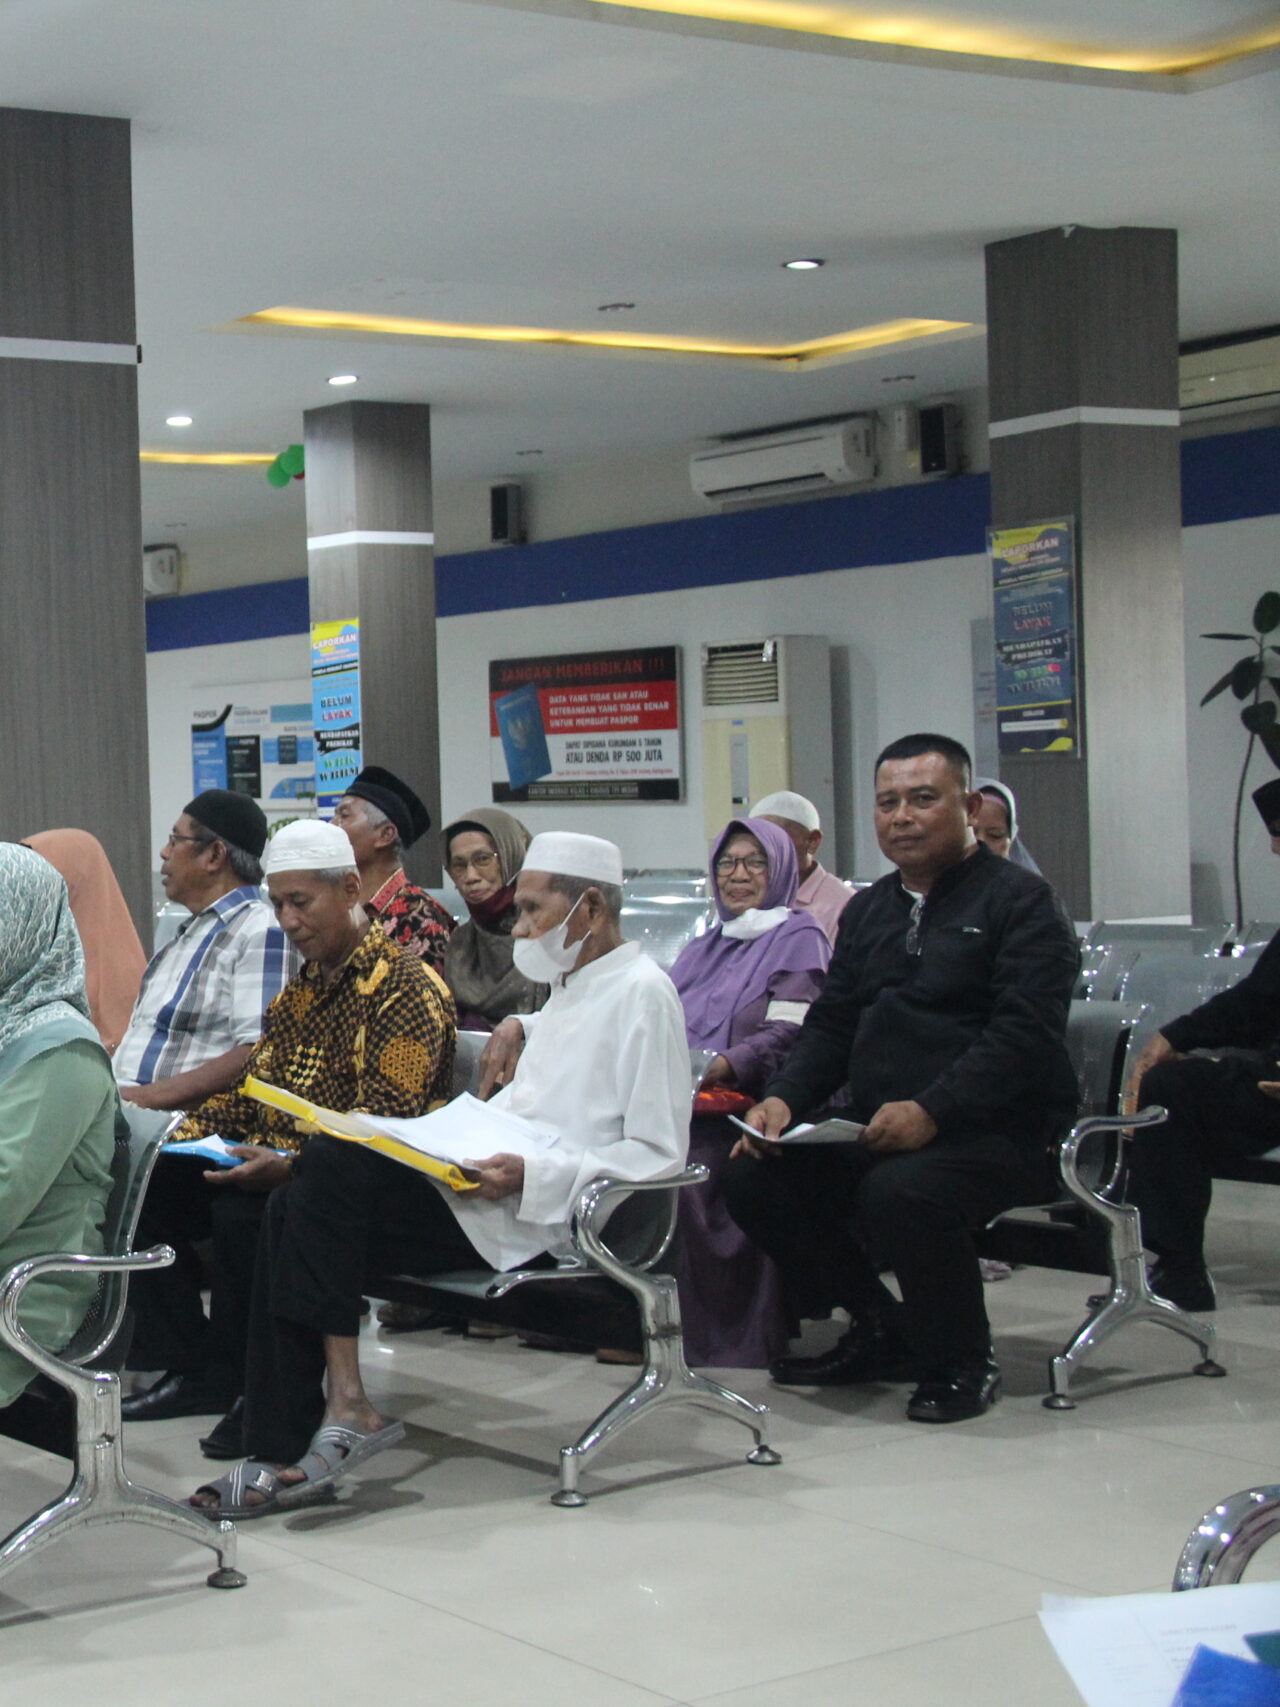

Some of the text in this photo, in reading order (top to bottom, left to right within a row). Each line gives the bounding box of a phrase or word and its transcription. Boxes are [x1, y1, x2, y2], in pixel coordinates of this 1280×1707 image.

[501, 666, 552, 682] JANGAN
[556, 659, 642, 678] MEMBERIKAN
[320, 695, 352, 708] BELUM
[549, 695, 567, 704] DATA
[569, 694, 588, 703] YANG
[590, 692, 610, 702] TIDAK
[629, 690, 648, 699] ATAU
[322, 708, 352, 721] LAYAK
[549, 701, 669, 715] KETERANGAN YANG TIDAK BENAR
[549, 715, 639, 728] UNTUK MEMBUAT PASPOR
[644, 737, 662, 746] TAHUN
[565, 749, 663, 764] ATAU DENDA RP 500 JUTA
